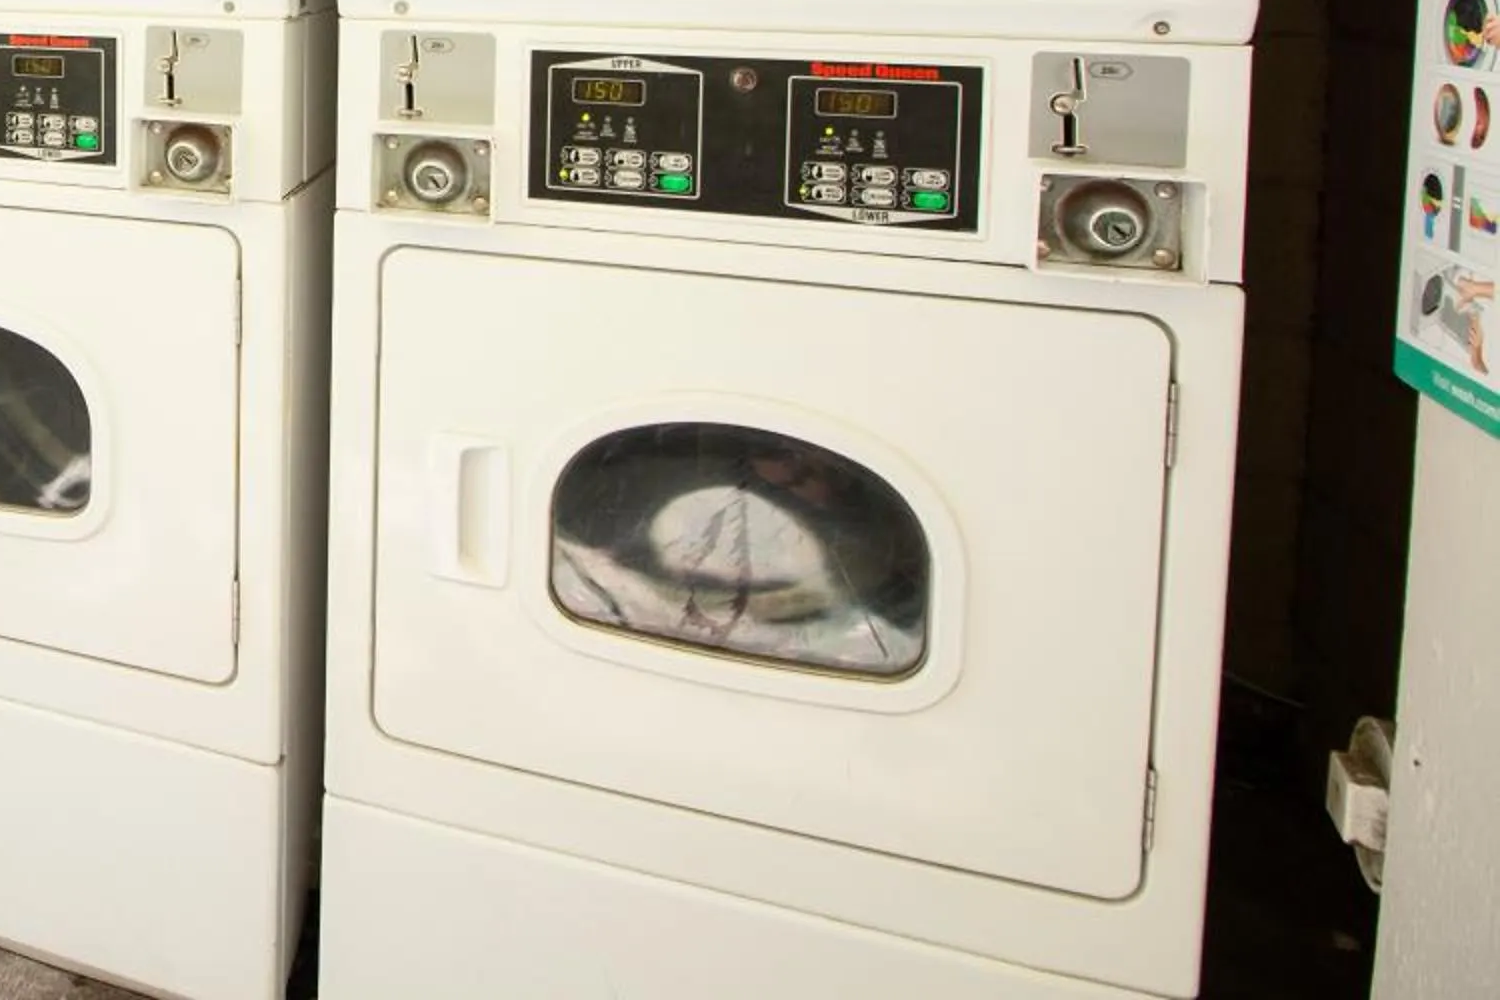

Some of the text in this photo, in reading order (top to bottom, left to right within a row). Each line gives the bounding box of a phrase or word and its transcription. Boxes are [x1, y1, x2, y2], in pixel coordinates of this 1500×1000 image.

[611, 58, 642, 69] UPPER
[810, 61, 940, 81] Speed Queen
[584, 81, 623, 100] 150
[852, 210, 890, 222] LOWER
